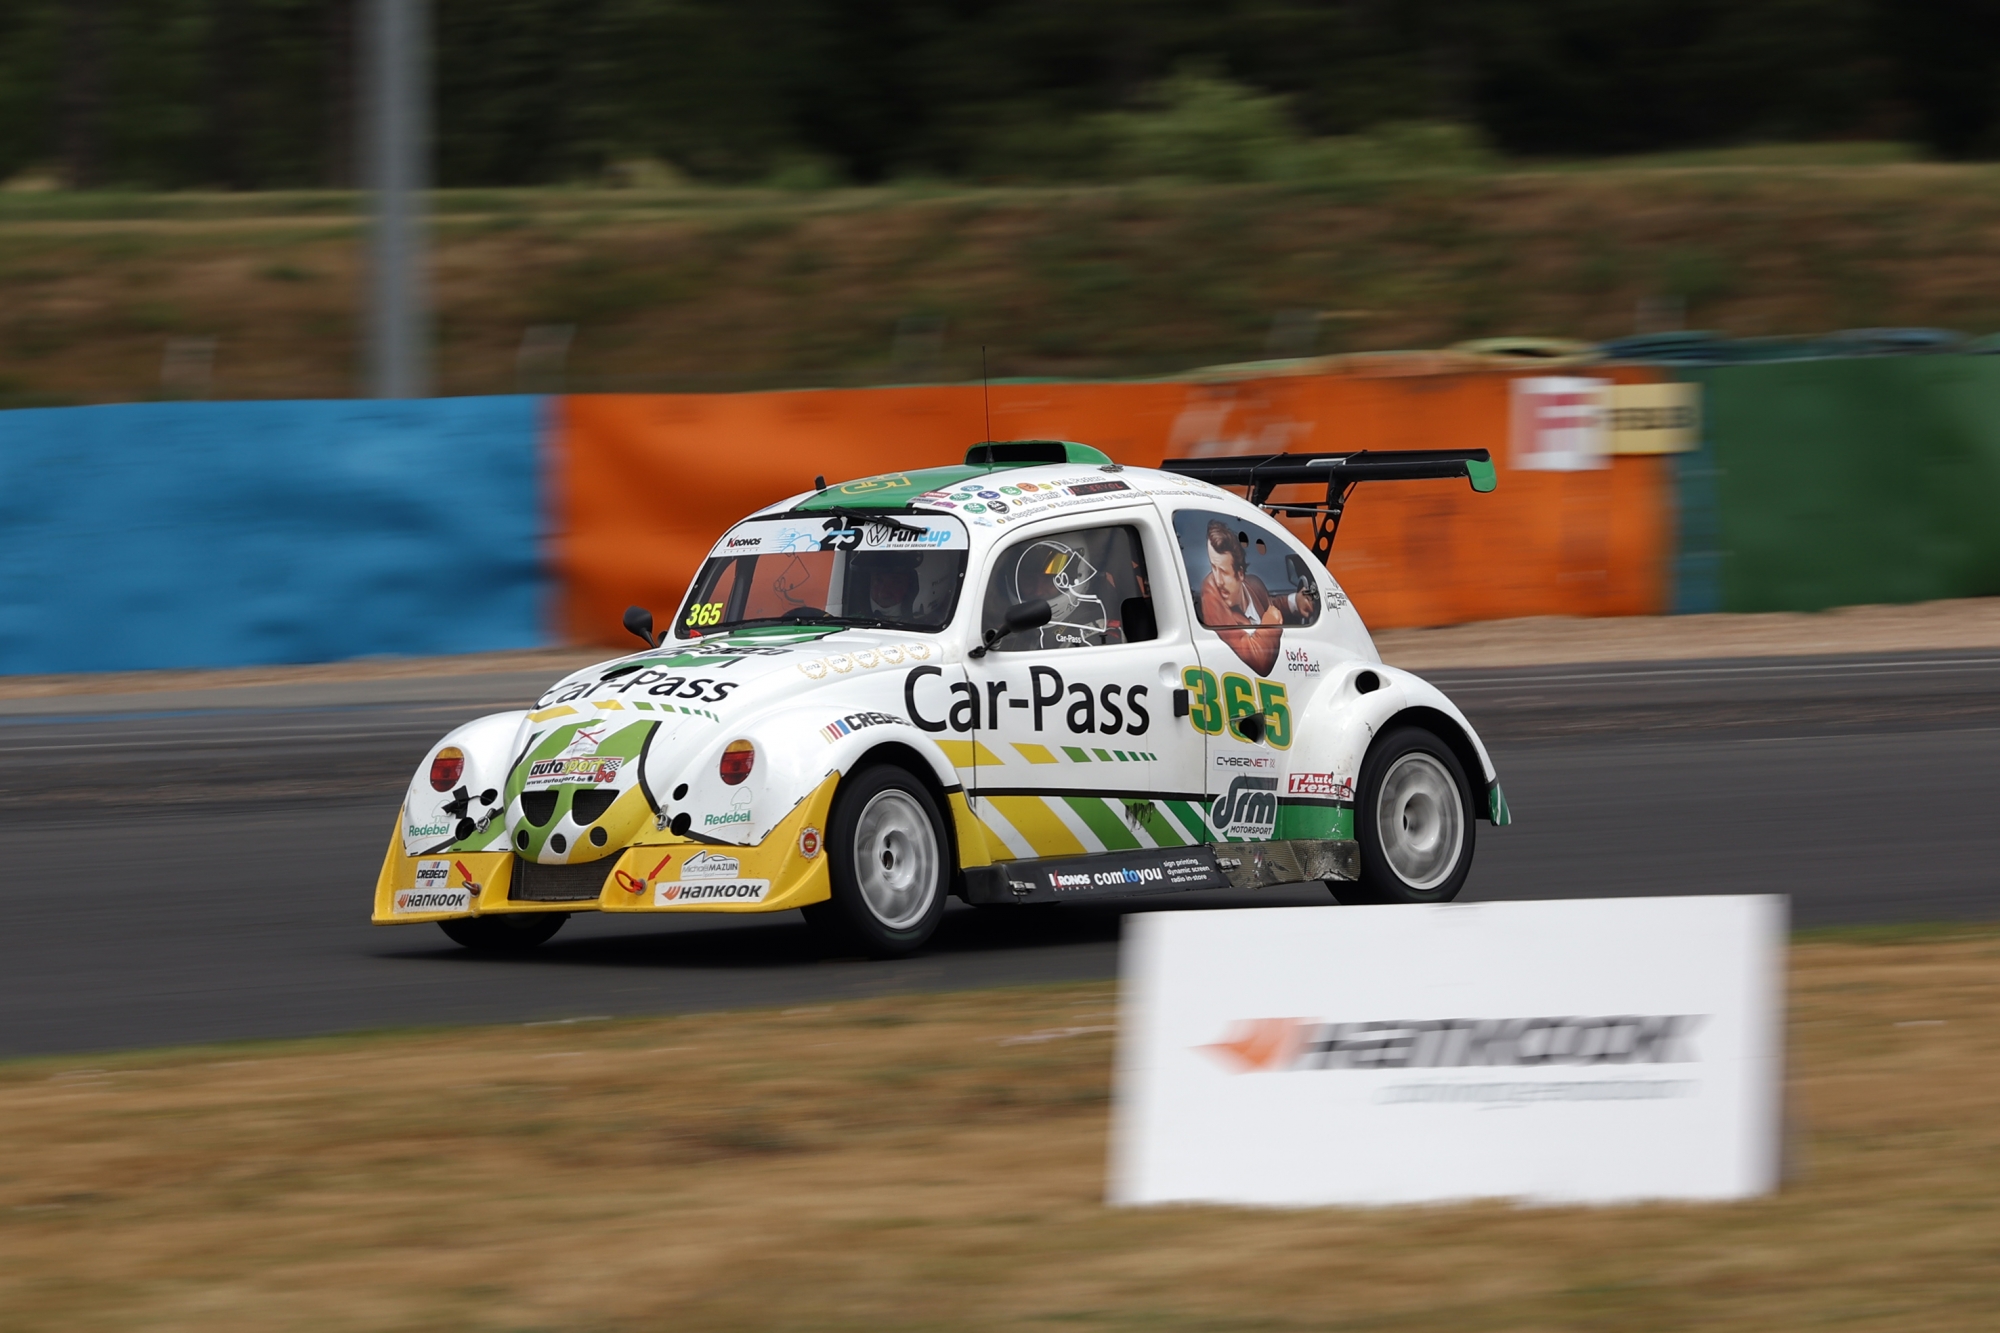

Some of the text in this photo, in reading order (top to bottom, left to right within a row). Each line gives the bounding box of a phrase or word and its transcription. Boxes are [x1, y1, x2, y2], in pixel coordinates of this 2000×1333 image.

[726, 535, 762, 547] KRONOS
[819, 518, 863, 551] 25
[686, 603, 724, 625] 365
[1056, 633, 1081, 643] Car-Pass
[1288, 660, 1320, 677] compact
[531, 669, 739, 711] Car-Pass
[904, 665, 1150, 735] Car-Pass
[1181, 665, 1293, 751] 365
[530, 758, 605, 775] autosport
[1216, 756, 1269, 767] CYBERNET
[526, 775, 586, 786] www.autosport.be
[704, 810, 752, 826] Redebel
[408, 823, 450, 837] Redebel
[1230, 825, 1272, 835] MOTORSPORT
[416, 869, 448, 879] CREDECO
[1048, 870, 1091, 888] KRONOS
[1094, 868, 1163, 886] comtoyou
[1166, 867, 1191, 876] dynamic
[1170, 875, 1185, 883] radio
